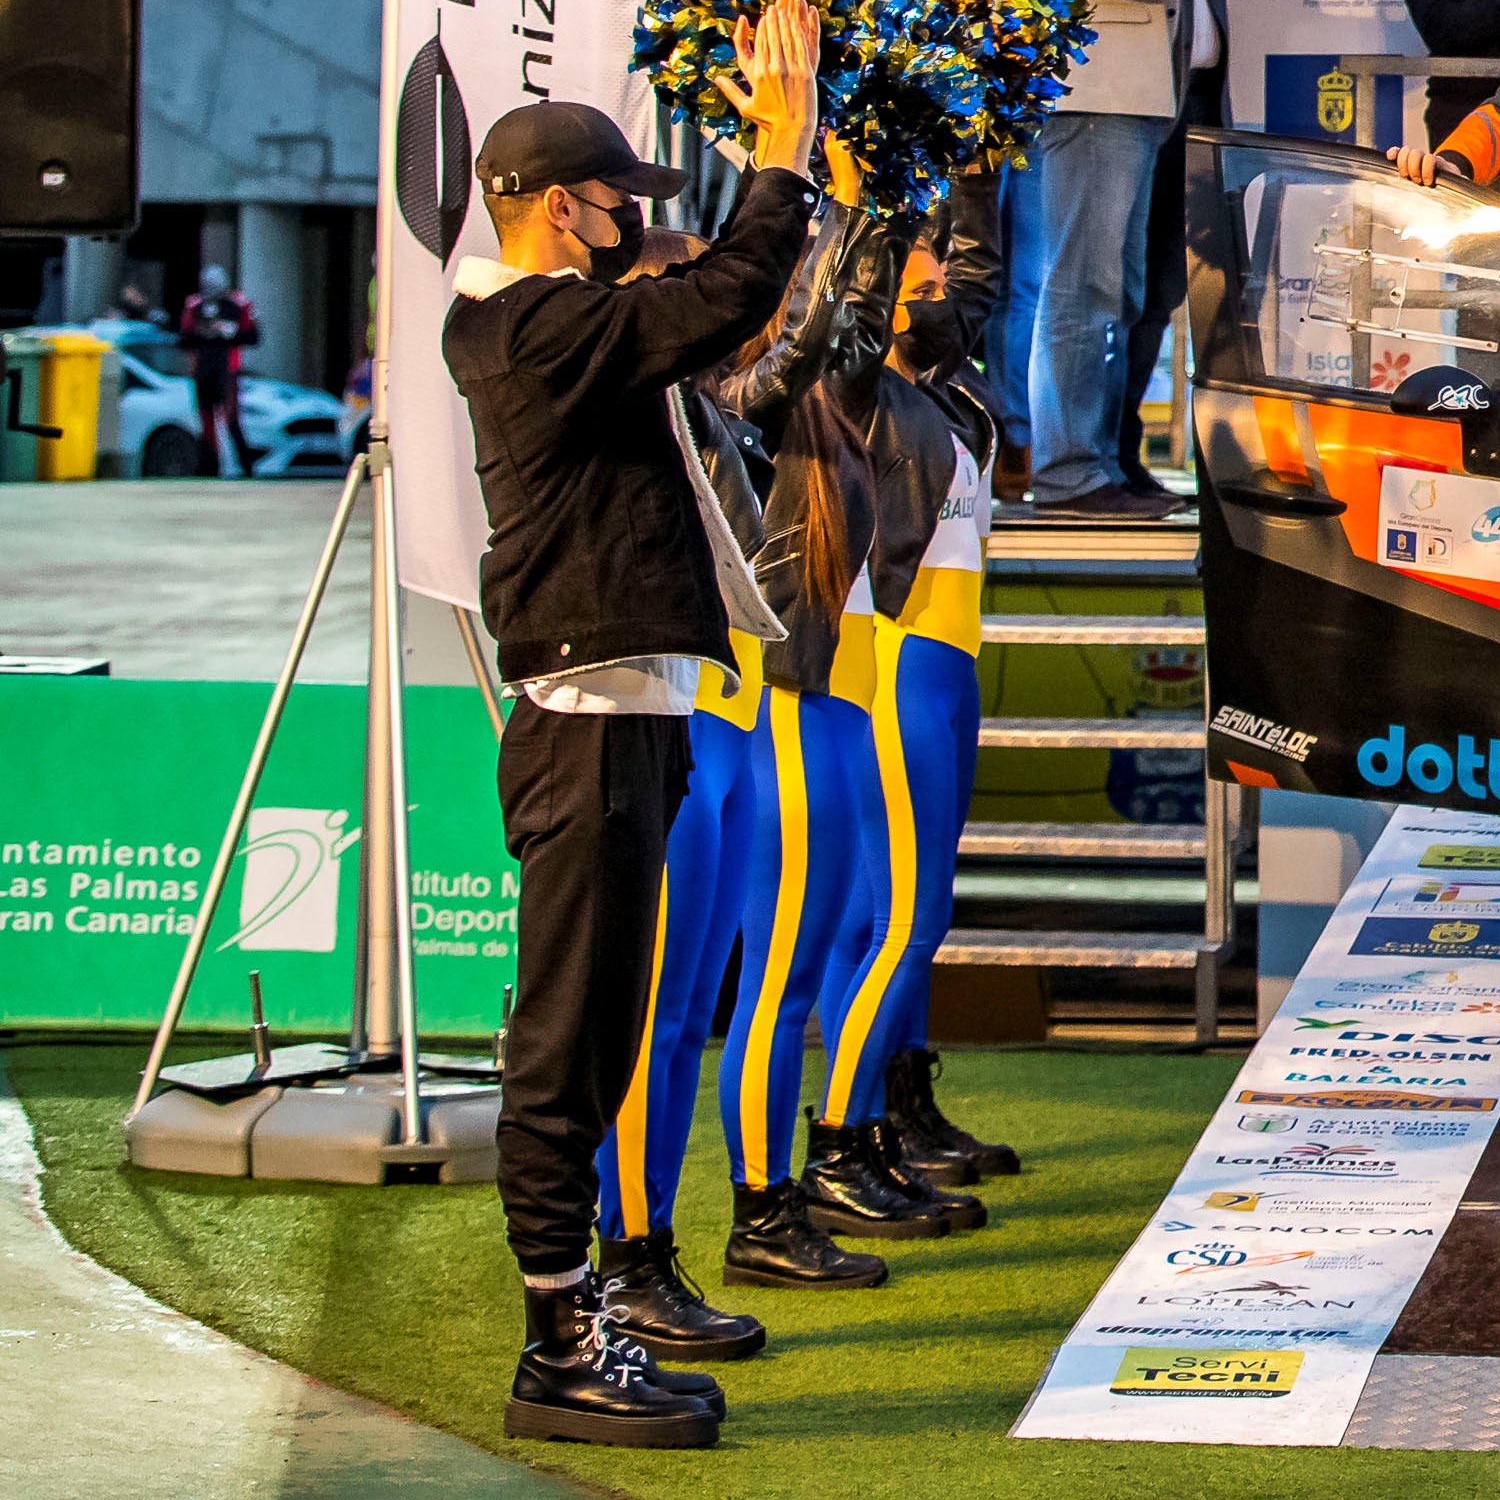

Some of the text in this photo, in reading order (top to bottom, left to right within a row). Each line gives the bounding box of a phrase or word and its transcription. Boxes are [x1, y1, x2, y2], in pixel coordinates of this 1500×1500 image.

[0, 837, 202, 869] ntamiento
[68, 872, 199, 903] Palmas
[0, 905, 196, 936] ran Canaria
[1215, 1153, 1397, 1170] LasPalmas
[1208, 1224, 1435, 1238] SONOCOM
[1166, 1247, 1249, 1270] CSD
[1137, 1295, 1356, 1311] LOPESAN
